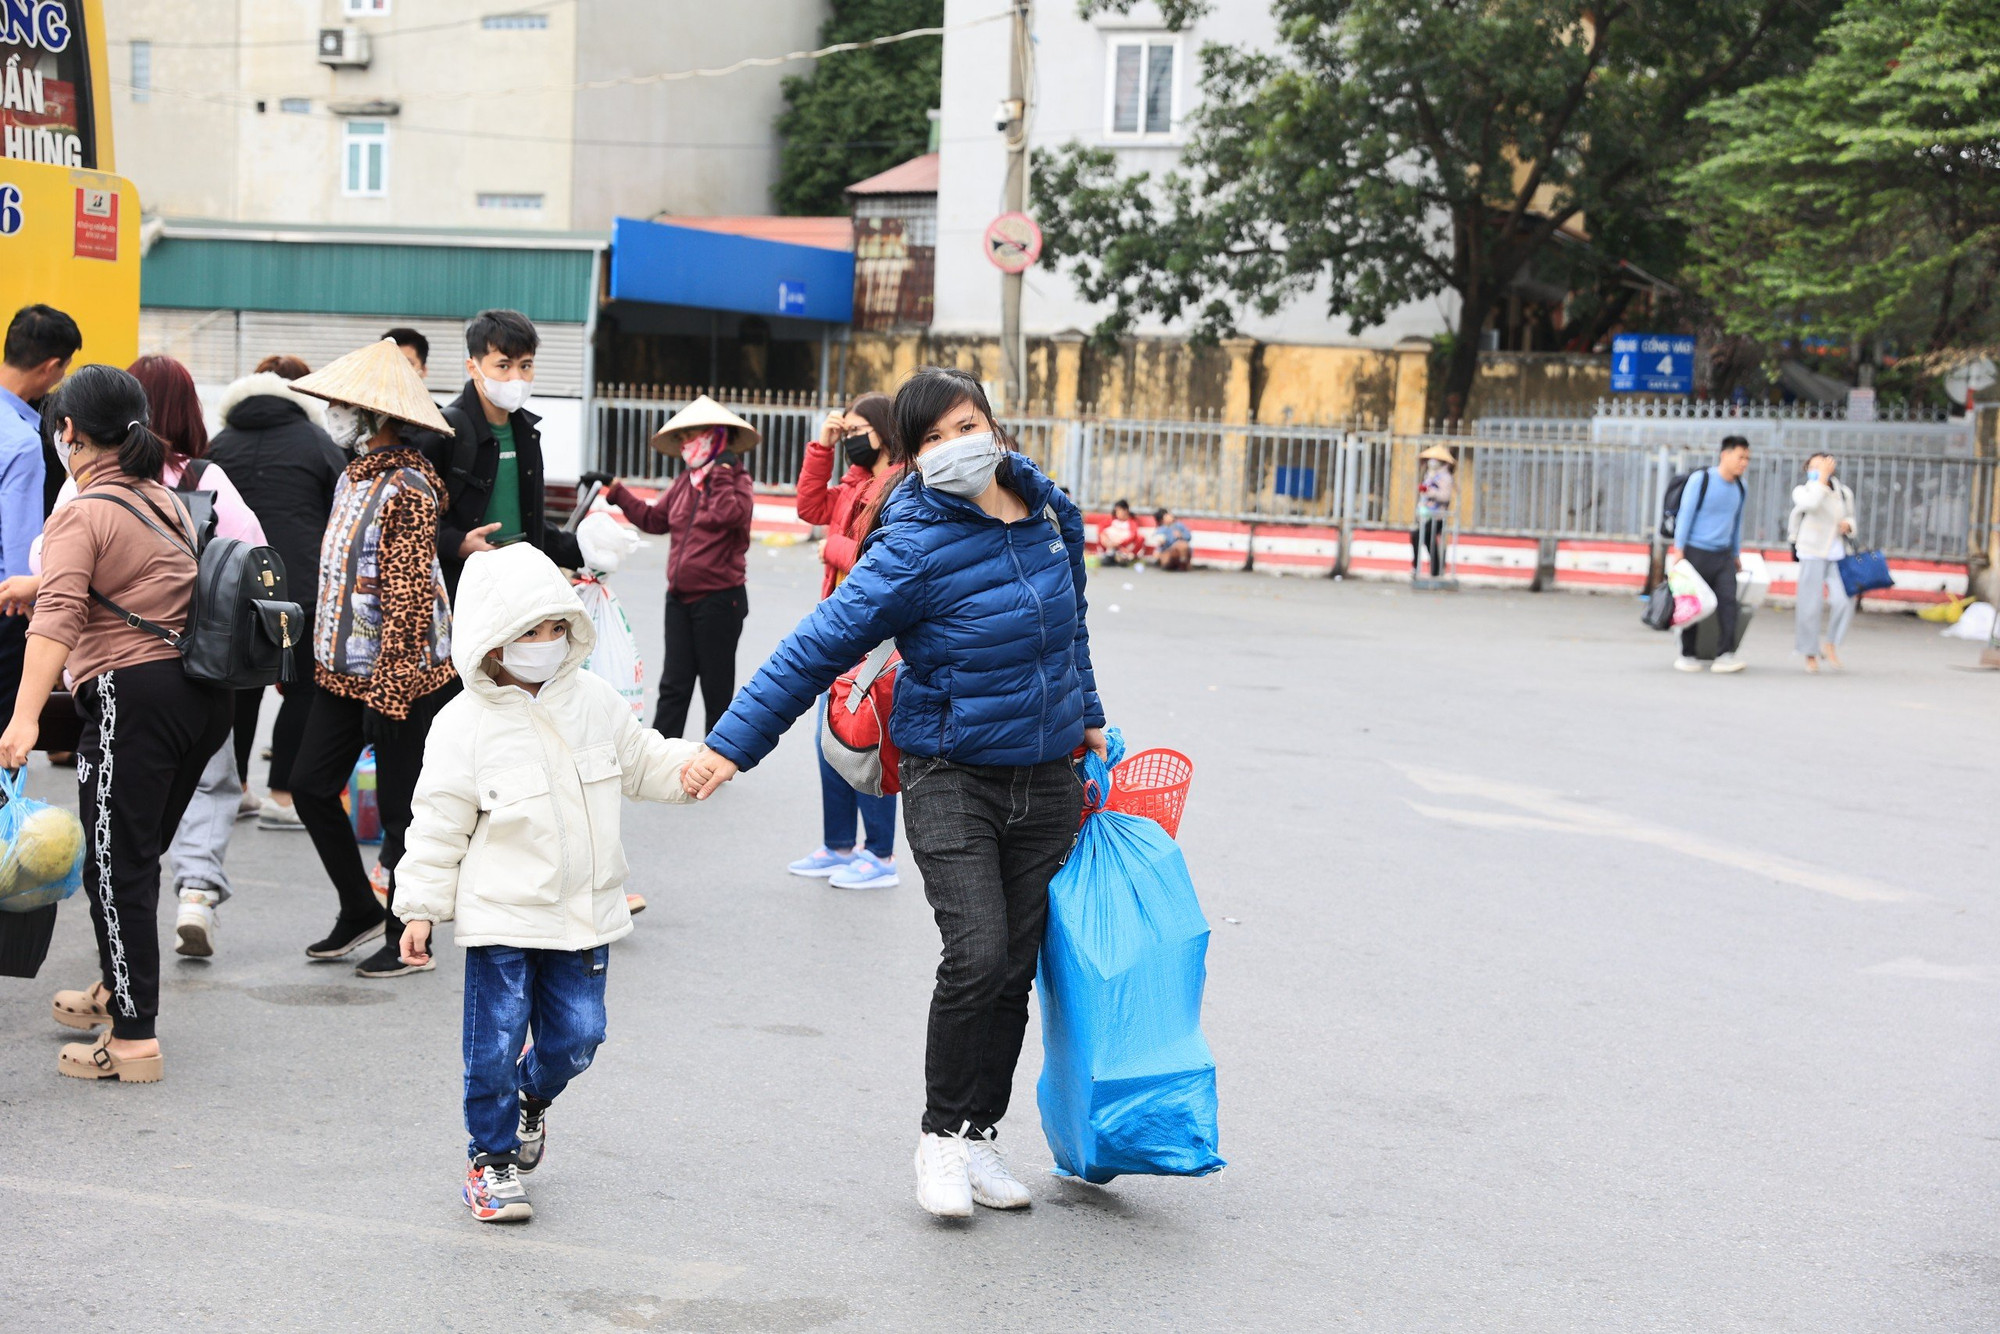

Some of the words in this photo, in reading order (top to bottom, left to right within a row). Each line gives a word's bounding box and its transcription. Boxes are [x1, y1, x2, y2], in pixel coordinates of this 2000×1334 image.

[0, 0, 71, 52] NG
[5, 124, 82, 168] HƯNG
[1656, 355, 1673, 376] 4
